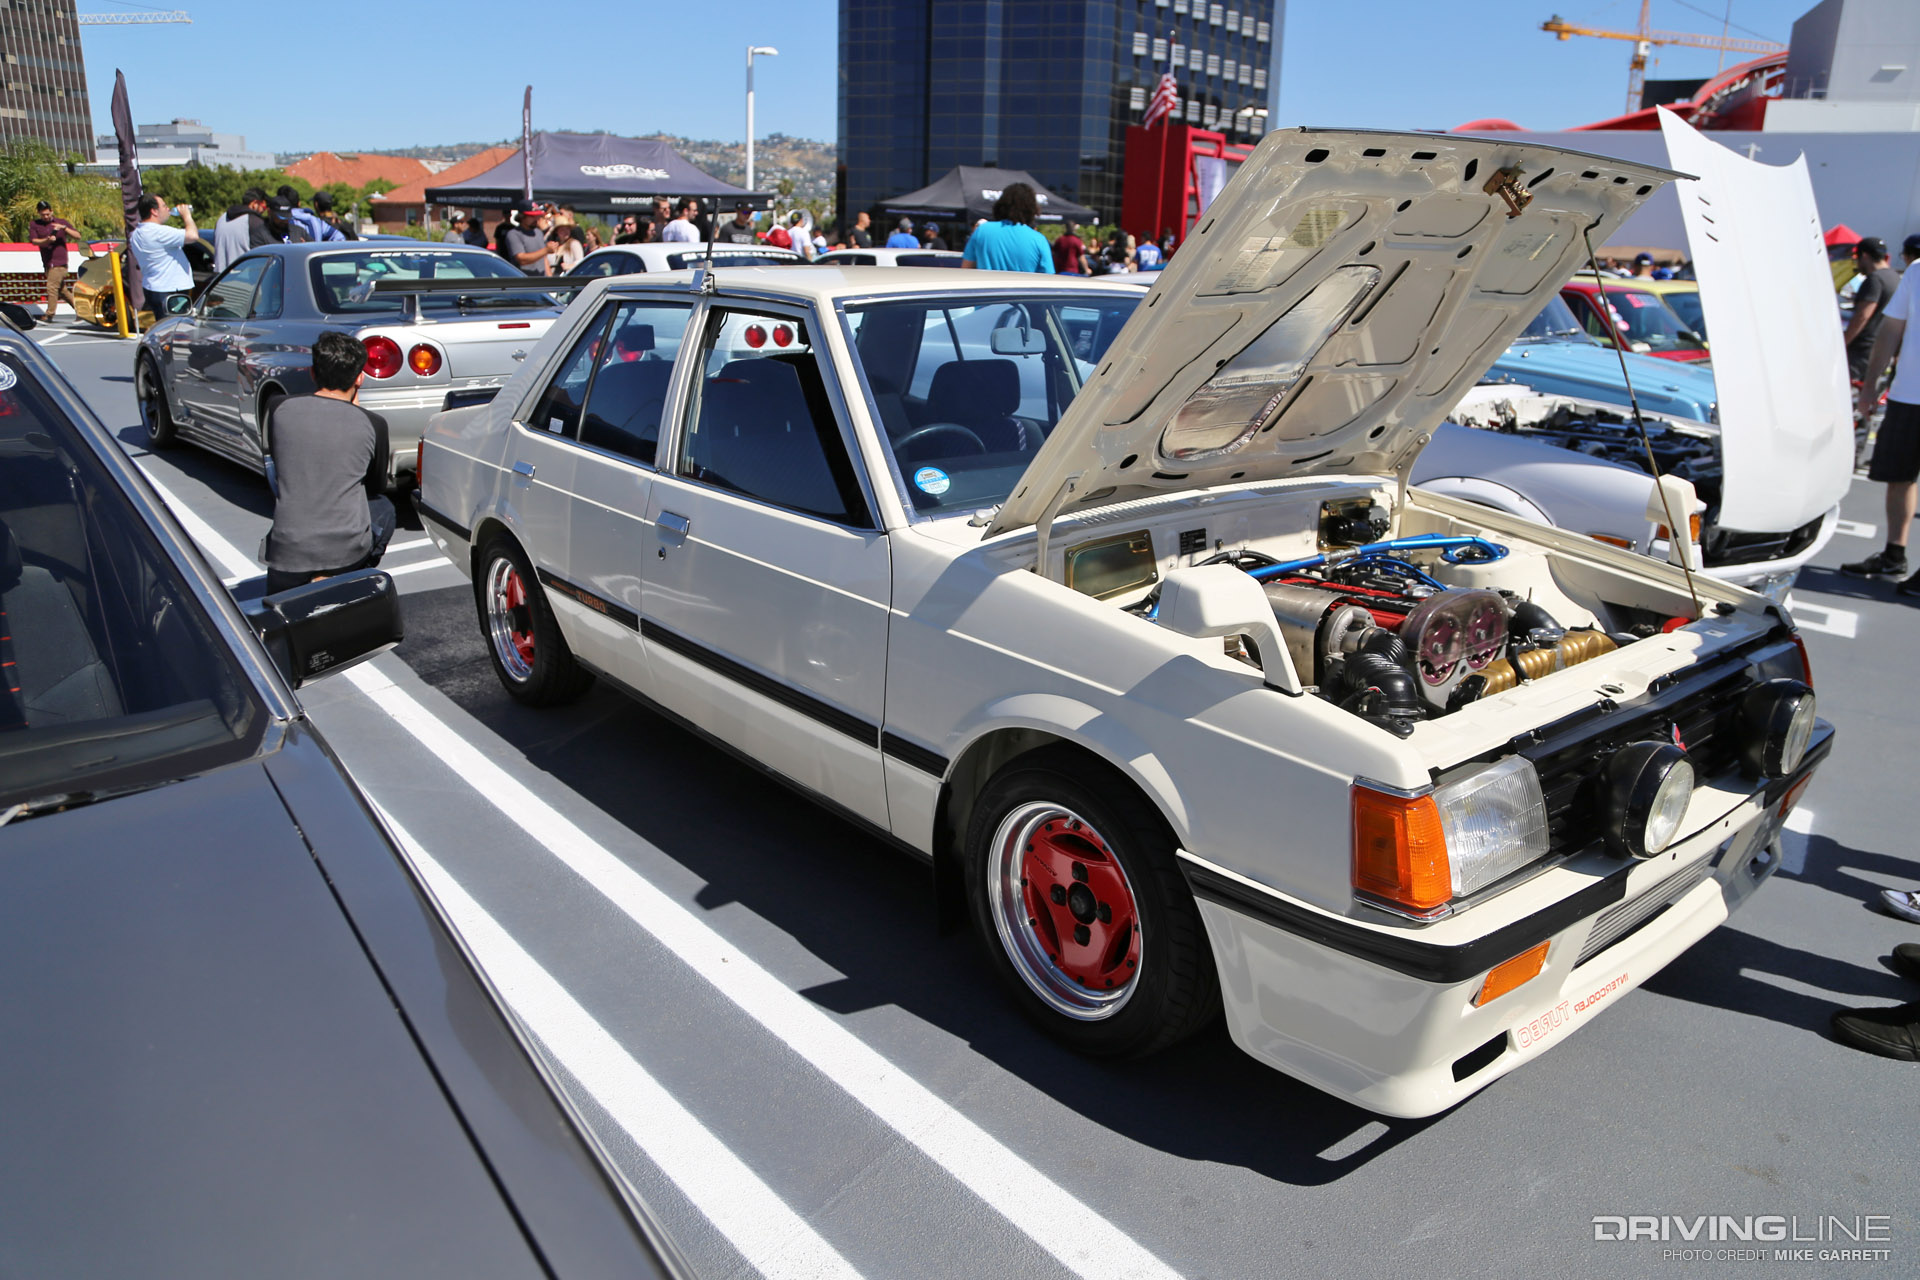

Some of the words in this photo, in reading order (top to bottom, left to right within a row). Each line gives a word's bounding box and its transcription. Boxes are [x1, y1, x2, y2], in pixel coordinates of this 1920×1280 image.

[580, 164, 636, 177] CONCEPT
[636, 167, 669, 178] ONE
[576, 590, 606, 612] TURBO
